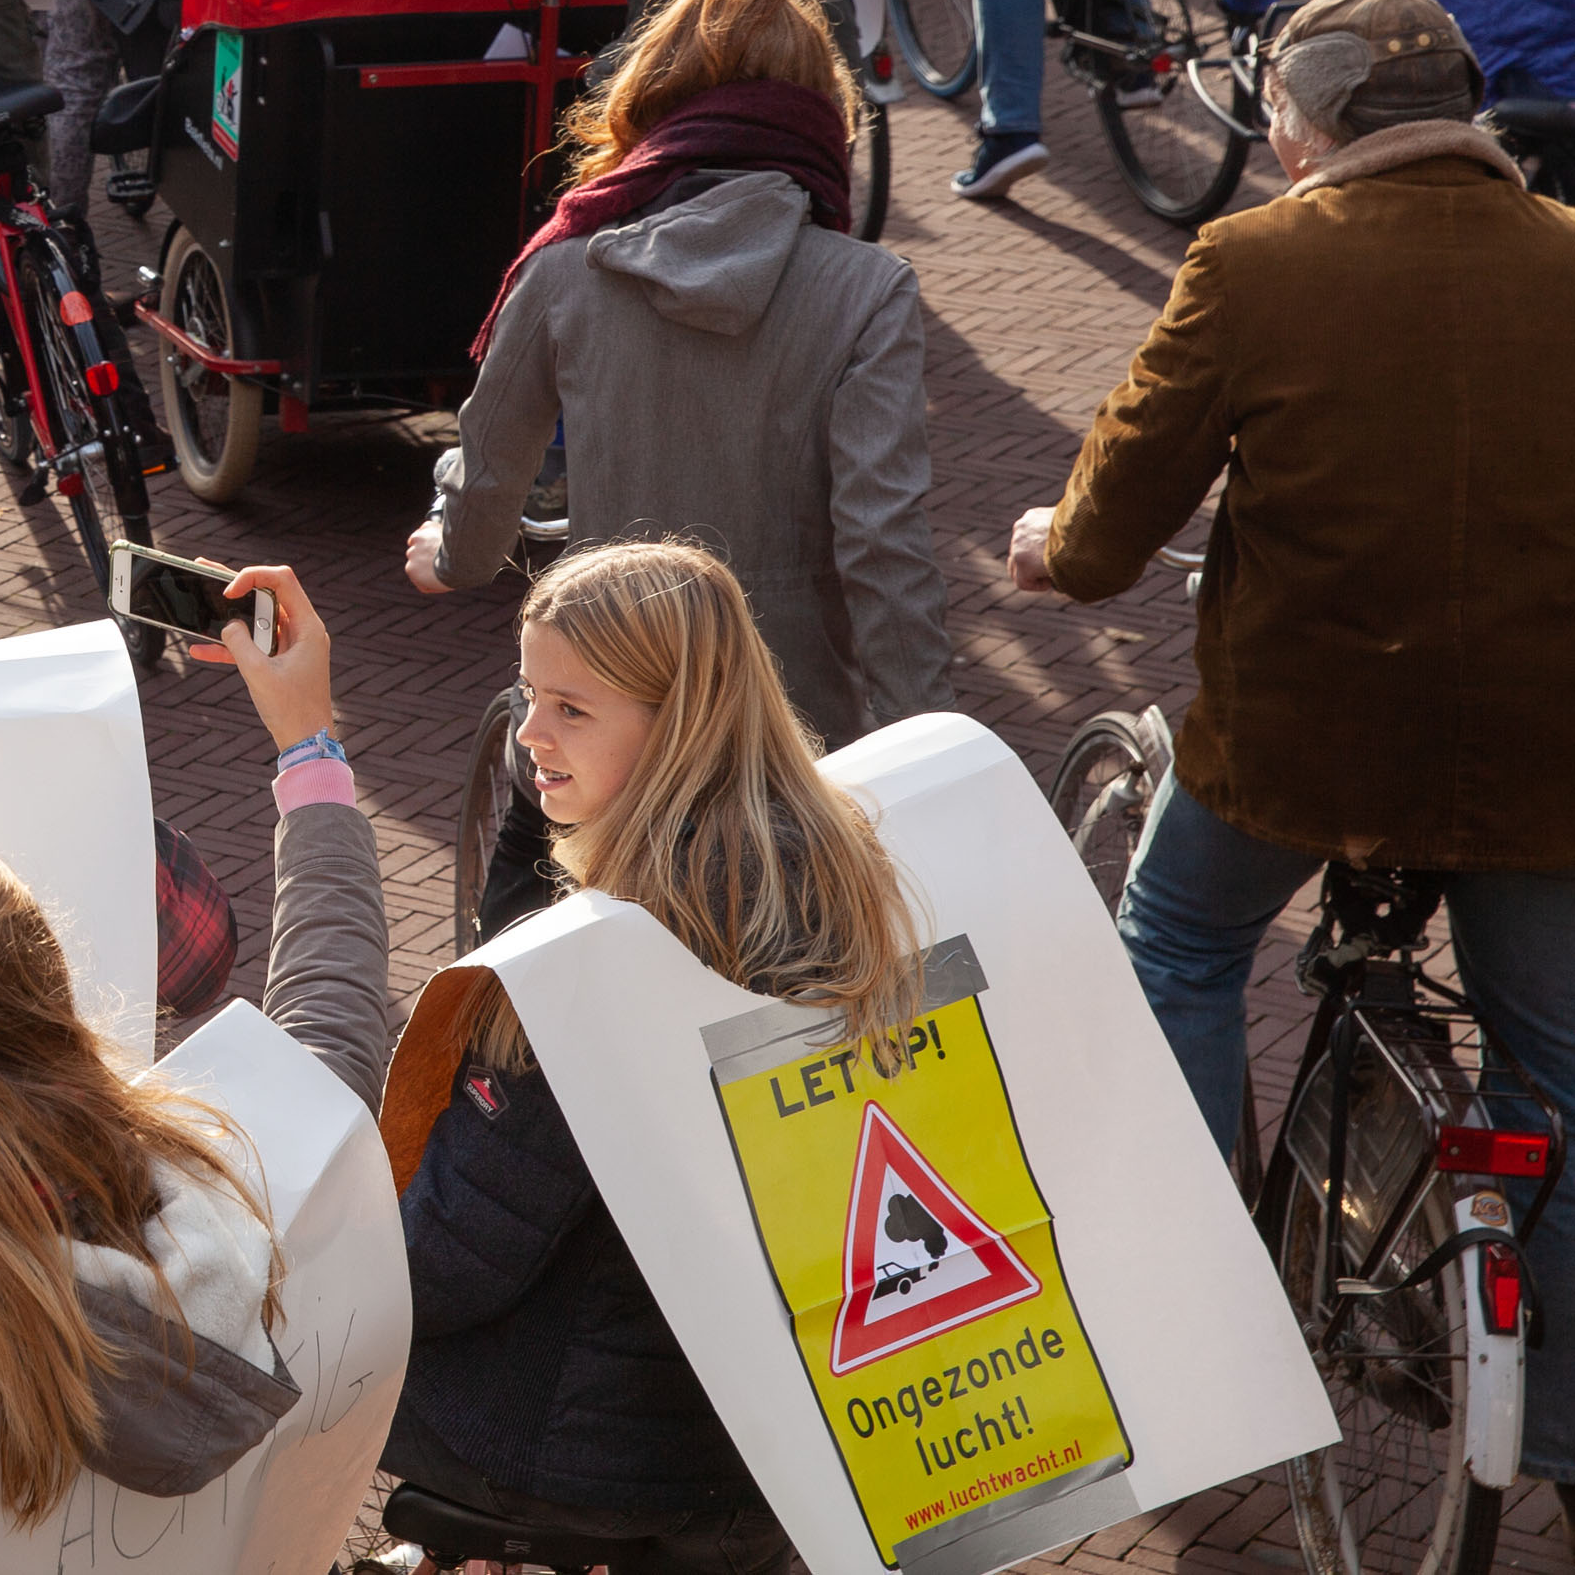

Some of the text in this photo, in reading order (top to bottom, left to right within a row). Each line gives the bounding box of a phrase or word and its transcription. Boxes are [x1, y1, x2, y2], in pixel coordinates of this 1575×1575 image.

[466, 1083, 495, 1114] SUPERDRY
[769, 1019, 948, 1120] LET OP!
[847, 1327, 1066, 1439] Ongezonde
[915, 1395, 1035, 1476] lucht!
[904, 1439, 1083, 1530] www.luchtwacht.nl
